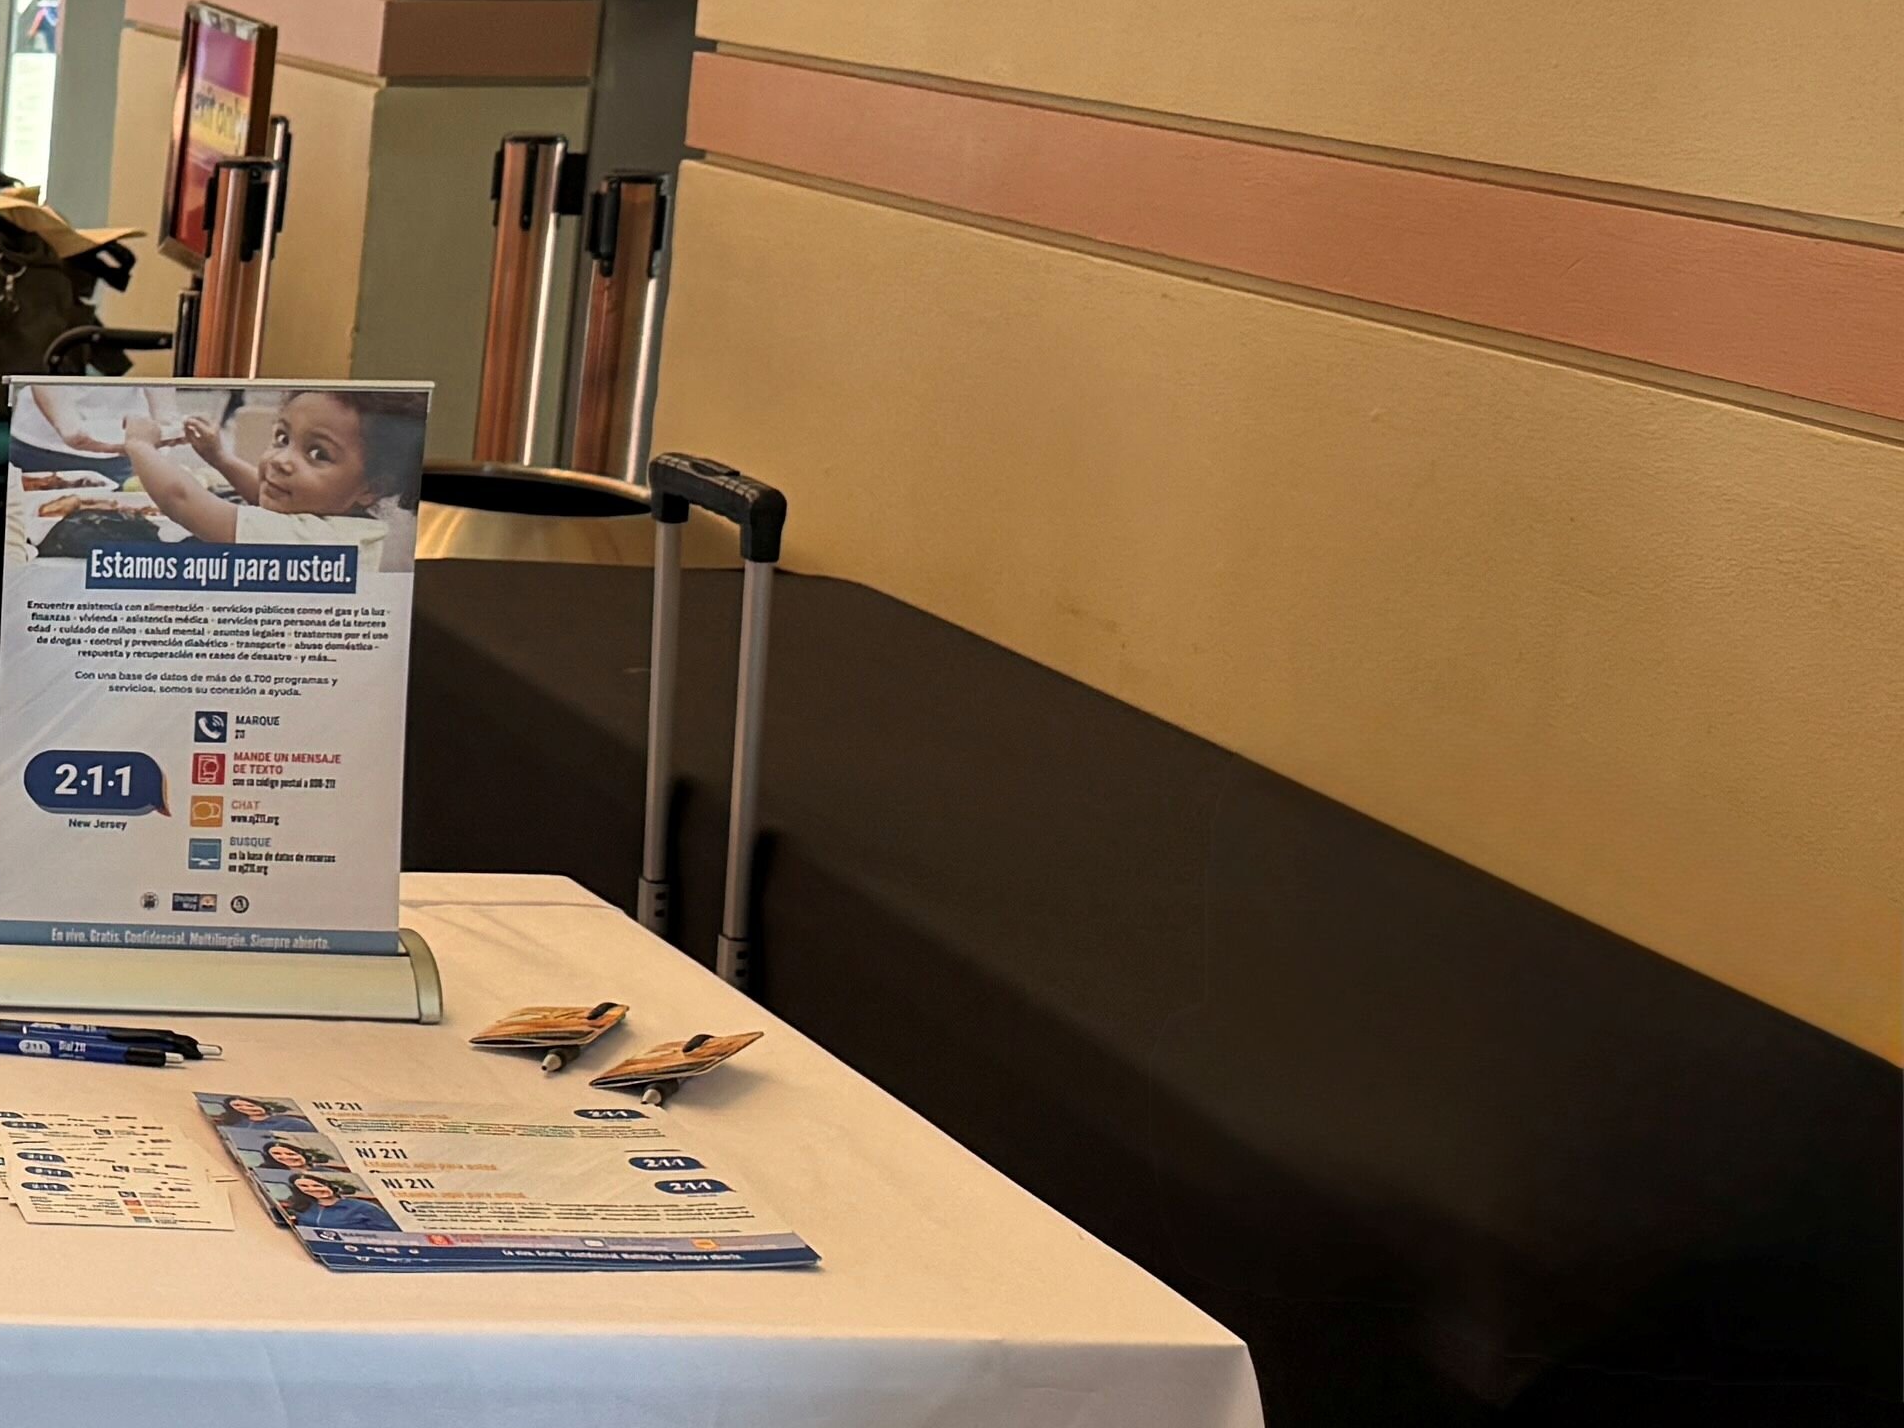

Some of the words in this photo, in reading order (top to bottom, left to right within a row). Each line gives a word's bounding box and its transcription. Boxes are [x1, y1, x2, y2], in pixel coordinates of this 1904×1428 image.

[91, 549, 178, 579] Estamos
[182, 551, 229, 586] aquí
[233, 556, 280, 587] para
[286, 554, 352, 583] usted.
[74, 670, 96, 680] Con
[97, 671, 117, 680] una
[118, 670, 143, 681] base
[144, 672, 159, 681] de
[160, 672, 189, 682] datos
[190, 673, 204, 682] de
[205, 673, 227, 683] más
[229, 674, 242, 683] de
[273, 675, 330, 687] programas
[331, 677, 339, 687] y
[235, 715, 281, 726] MARQUE
[233, 752, 272, 762] MANDE
[274, 752, 288, 763] UN
[291, 753, 342, 764] MENSAJE
[233, 763, 248, 774] DE
[250, 764, 283, 775] TEXTO
[231, 799, 260, 810] CHAT
[68, 818, 91, 828] New
[93, 819, 128, 830] Jersey
[229, 836, 272, 847] BUSQUE
[250, 933, 291, 949] Siempre
[312, 1101, 332, 1110] NJ
[335, 1102, 363, 1111] 211
[356, 1147, 375, 1158] NJ
[379, 1148, 408, 1159] 211
[381, 1178, 400, 1189] NJ
[405, 1178, 435, 1189] 211
